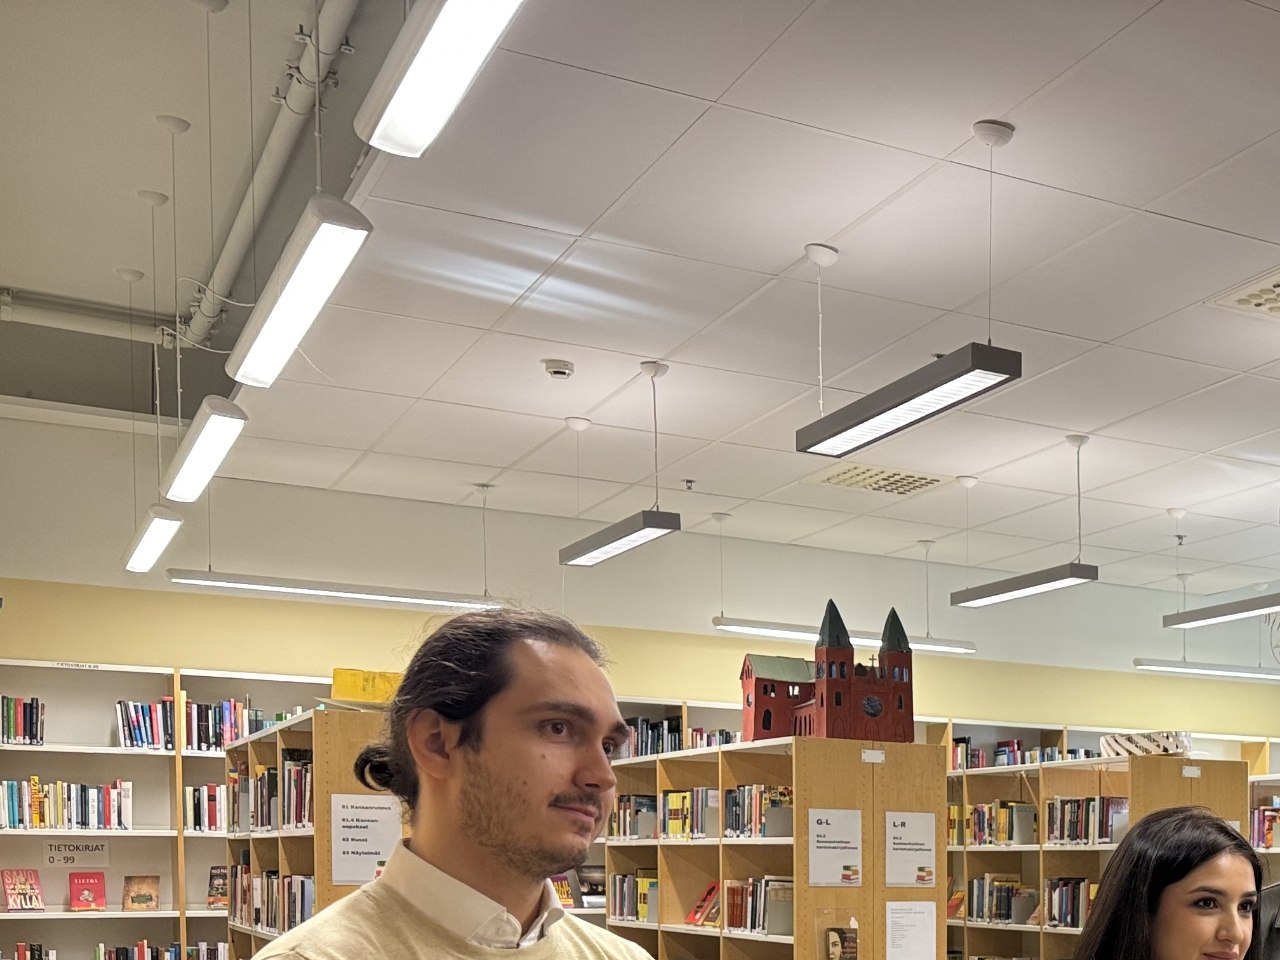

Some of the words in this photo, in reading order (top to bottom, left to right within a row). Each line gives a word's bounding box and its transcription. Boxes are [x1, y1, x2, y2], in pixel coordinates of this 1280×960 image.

[48, 844, 105, 852] TIETOKIRJAT
[48, 856, 55, 864] 0
[63, 856, 75, 864] 99
